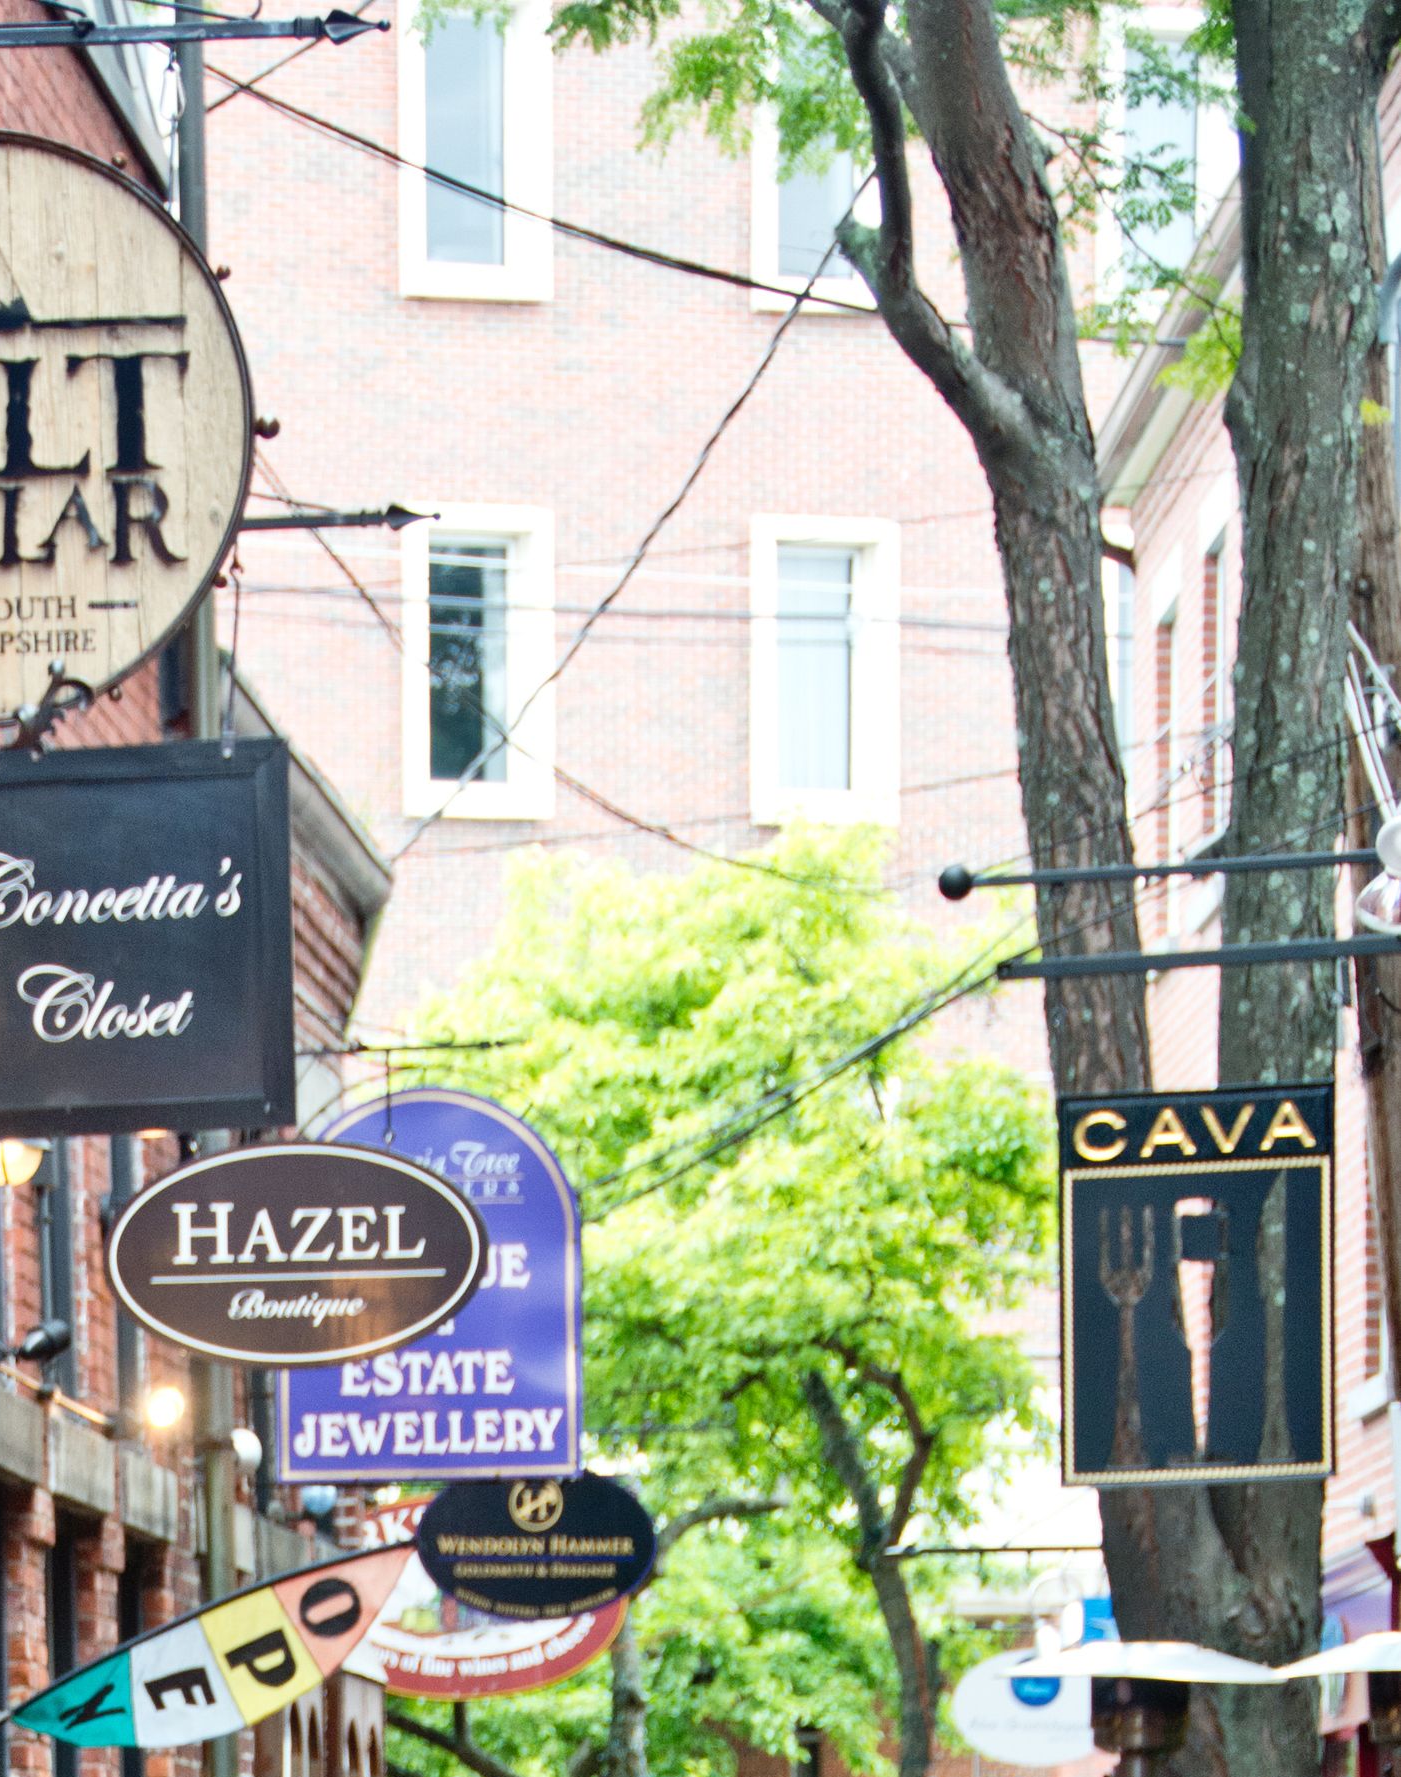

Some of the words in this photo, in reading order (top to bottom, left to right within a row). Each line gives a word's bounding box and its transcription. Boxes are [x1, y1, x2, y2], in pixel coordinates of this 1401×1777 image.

[16, 963, 194, 1043] Closet
[1071, 1099, 1318, 1163] CAVA
[170, 1200, 428, 1267] HAZEL
[227, 1287, 368, 1329] Boutique
[340, 1349, 516, 1398] ESTATE
[293, 1407, 565, 1459] JEWELLERY
[548, 1533, 636, 1557] HAMMER
[60, 1575, 363, 1732] OPEN
